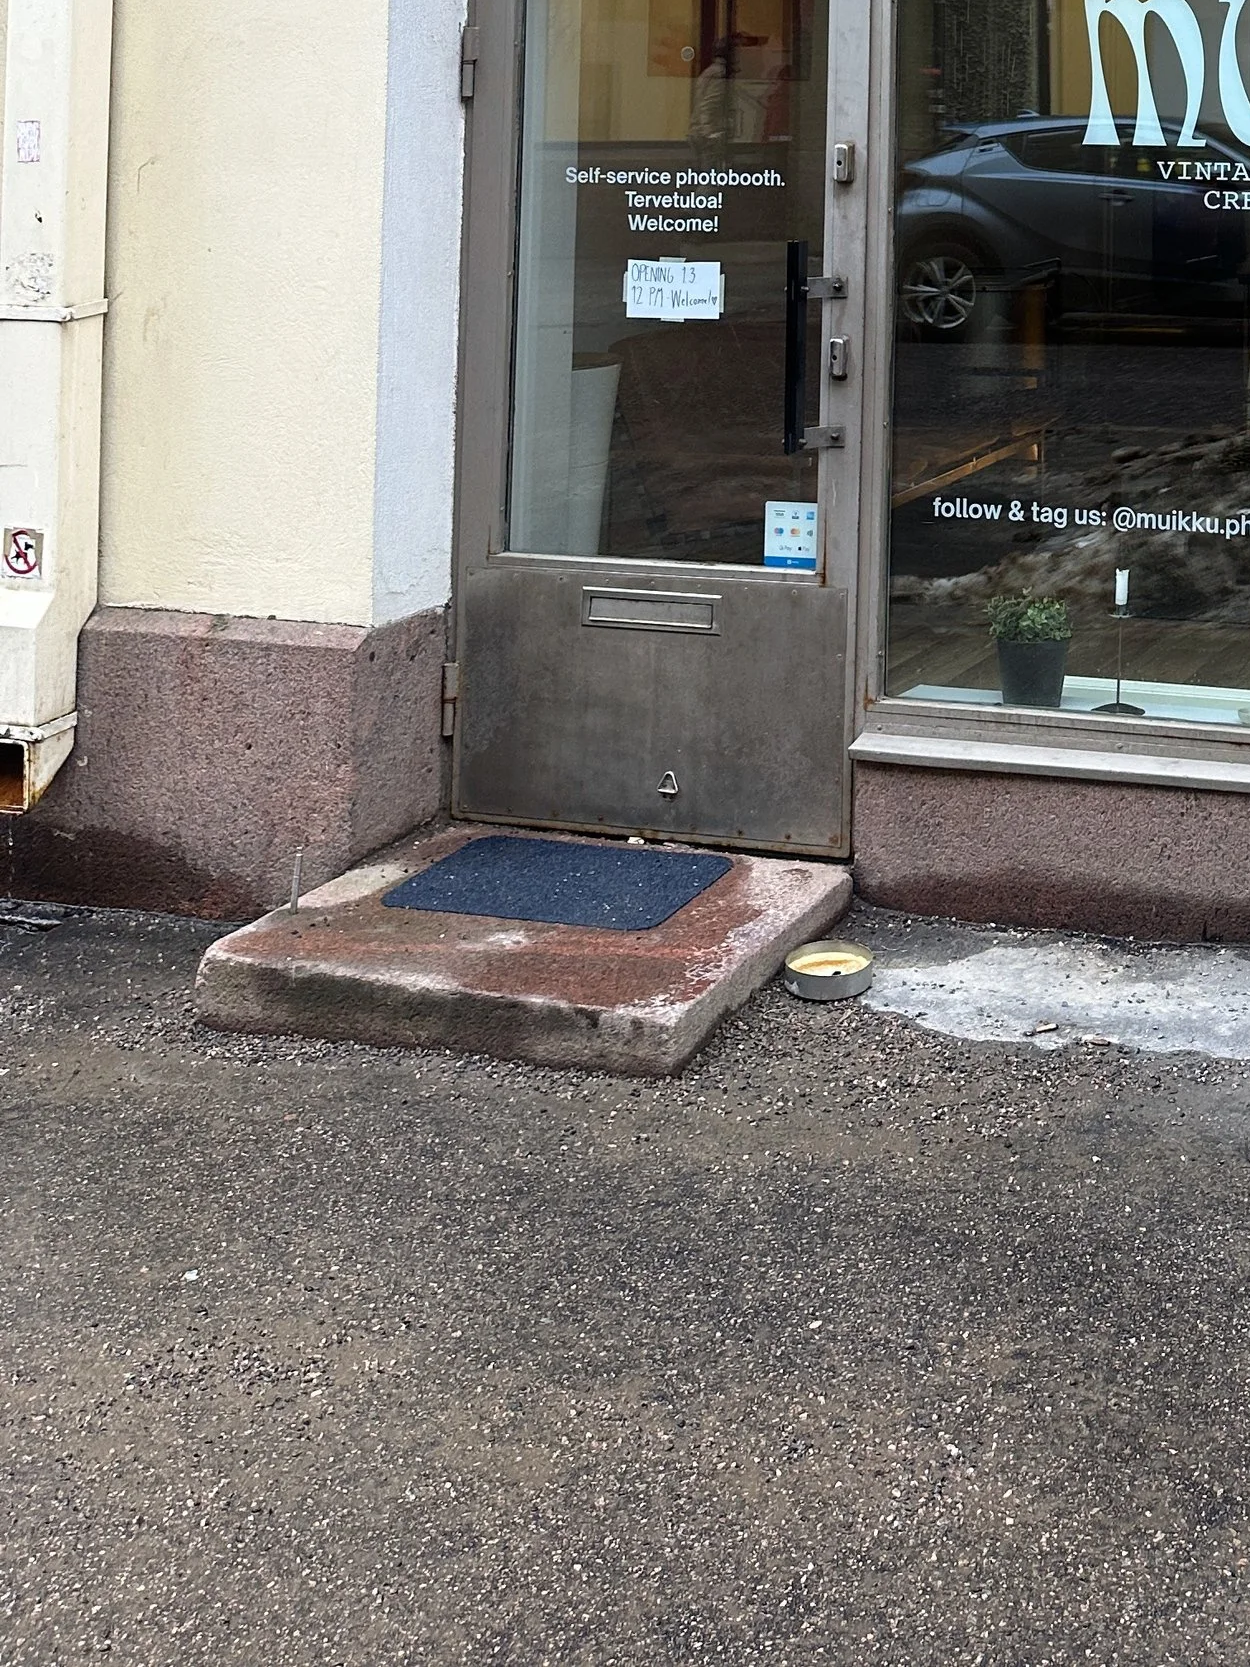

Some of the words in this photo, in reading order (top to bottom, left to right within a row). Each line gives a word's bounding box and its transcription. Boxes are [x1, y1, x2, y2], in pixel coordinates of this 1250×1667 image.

[565, 166, 671, 184] Self-service
[676, 168, 786, 188] photobooth.
[625, 190, 723, 209] Tervetuloa!
[628, 214, 719, 232] Welcome!
[631, 263, 674, 284] OPENING
[631, 285, 643, 305] 12
[649, 287, 664, 307] PM
[933, 497, 1002, 520] follow
[1008, 500, 1025, 522] &
[1031, 501, 1068, 529] tag
[1075, 508, 1107, 526] us:
